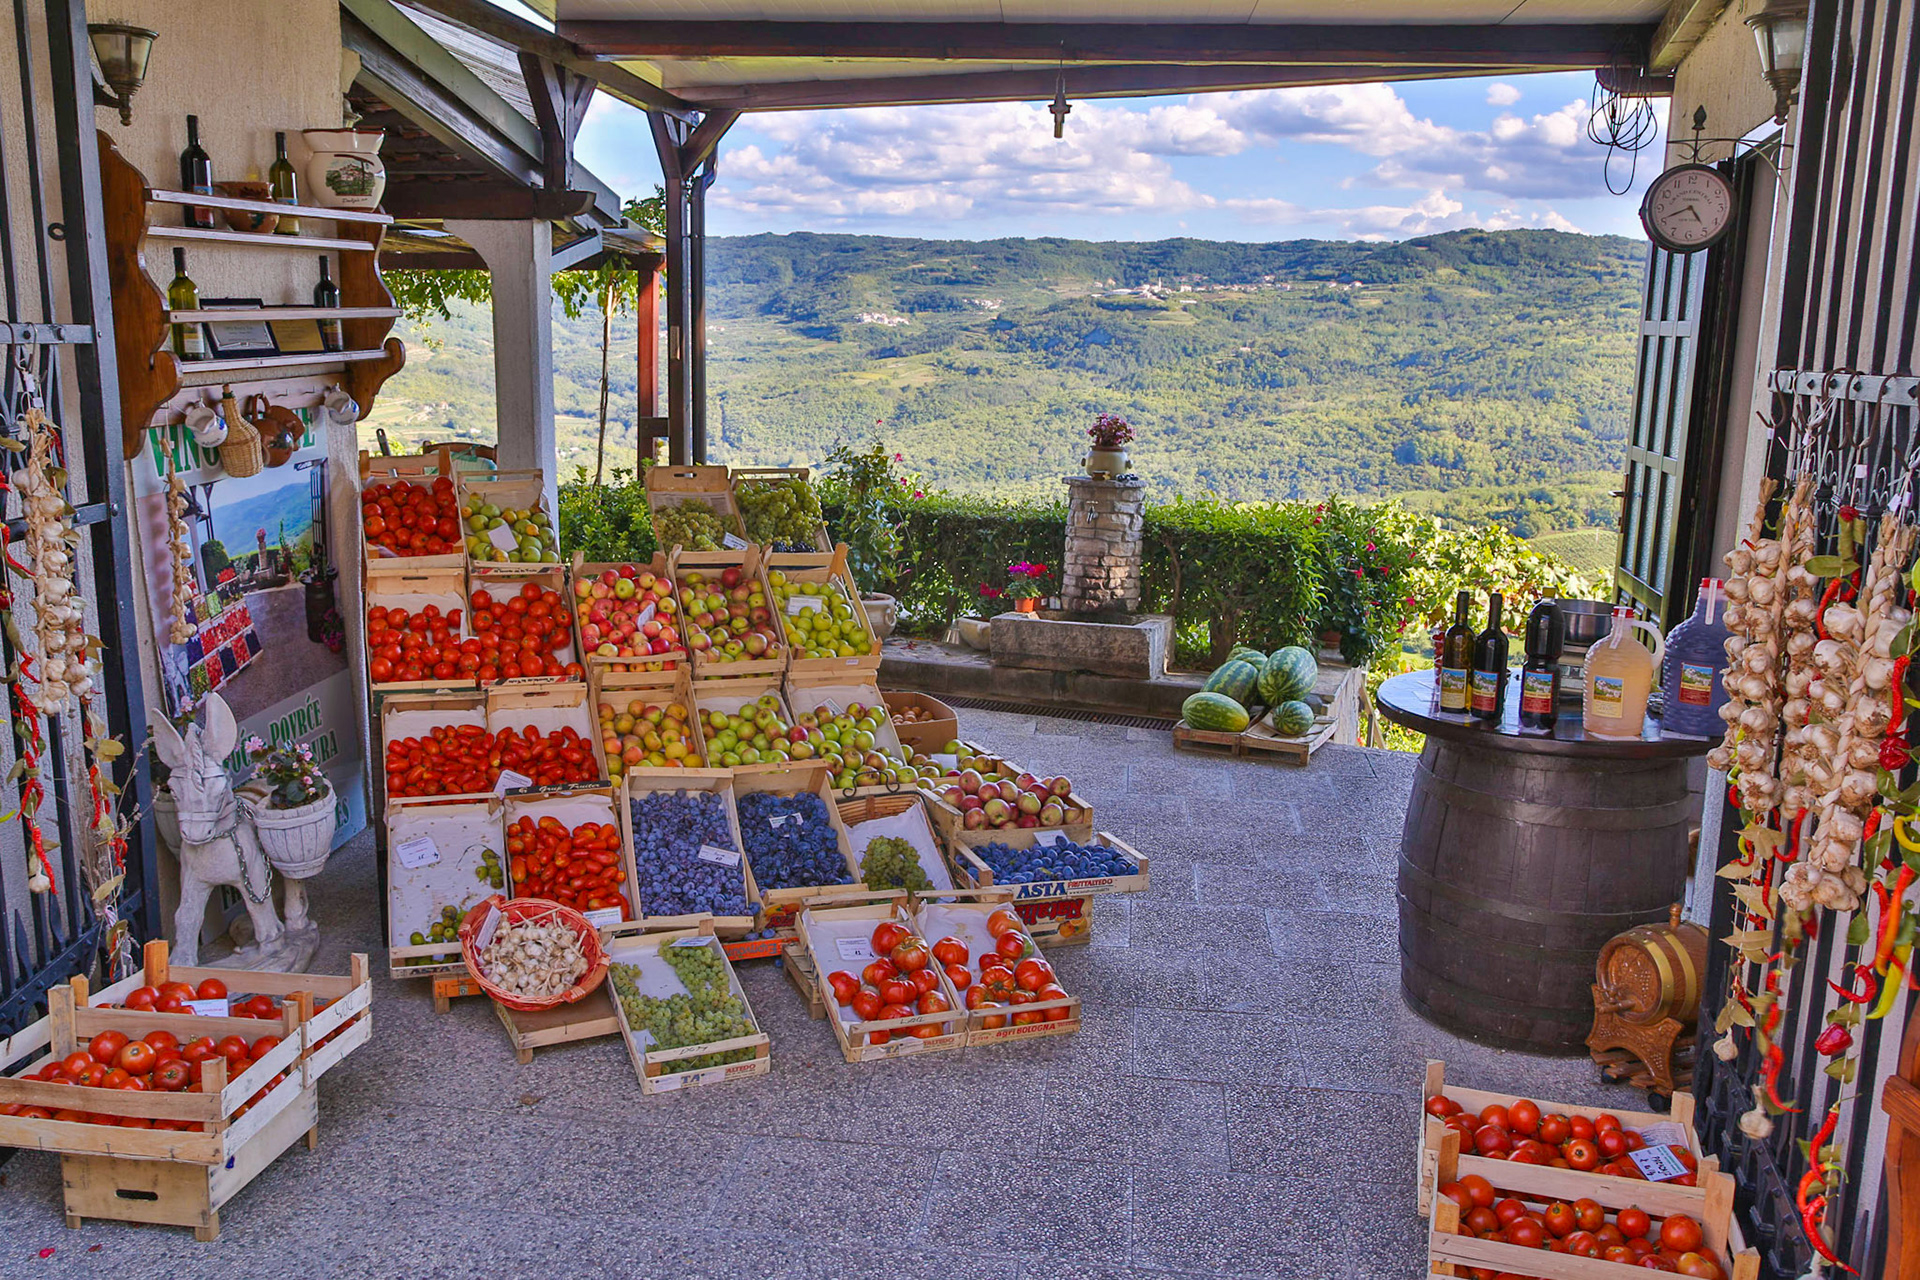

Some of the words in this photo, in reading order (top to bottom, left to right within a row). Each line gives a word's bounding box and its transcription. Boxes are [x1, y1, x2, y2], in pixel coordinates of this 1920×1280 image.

[1673, 179, 1681, 188] 11
[1688, 175, 1698, 184] 12
[1662, 189, 1671, 199] 10
[1714, 189, 1721, 199] 2
[1657, 203, 1664, 213] 9
[1717, 203, 1724, 212] 3
[1661, 217, 1667, 226] 8
[1712, 217, 1718, 225] 4
[1671, 227, 1677, 236] 7
[1684, 230, 1692, 240] 6
[1700, 227, 1708, 238] 5
[1016, 882, 1067, 899] ASTA
